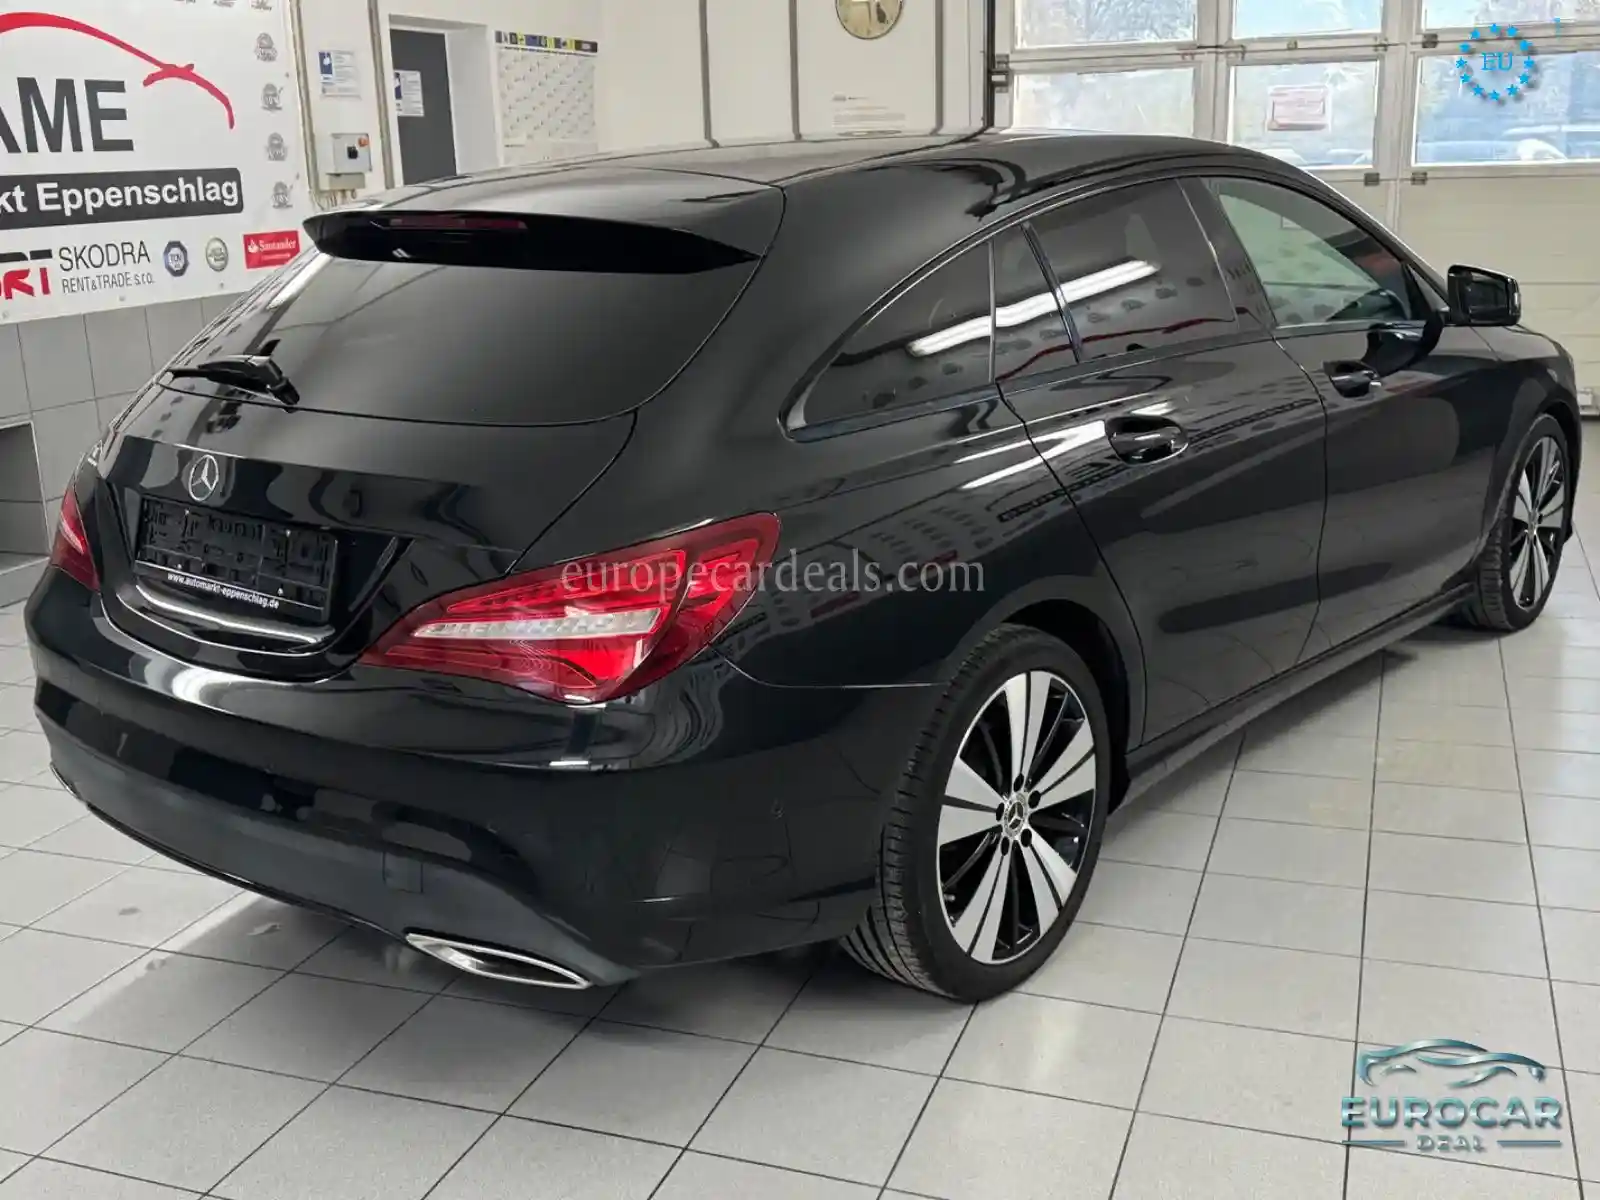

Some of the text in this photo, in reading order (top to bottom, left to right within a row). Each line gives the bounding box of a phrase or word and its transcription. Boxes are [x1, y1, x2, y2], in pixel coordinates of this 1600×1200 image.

[36, 176, 239, 216] Eppenschlag
[58, 240, 151, 272] SKODRA
[259, 237, 296, 252] Santander
[62, 272, 132, 293] RENT&TRADE
[167, 572, 280, 609] www.automarkt-eppenschlag.de
